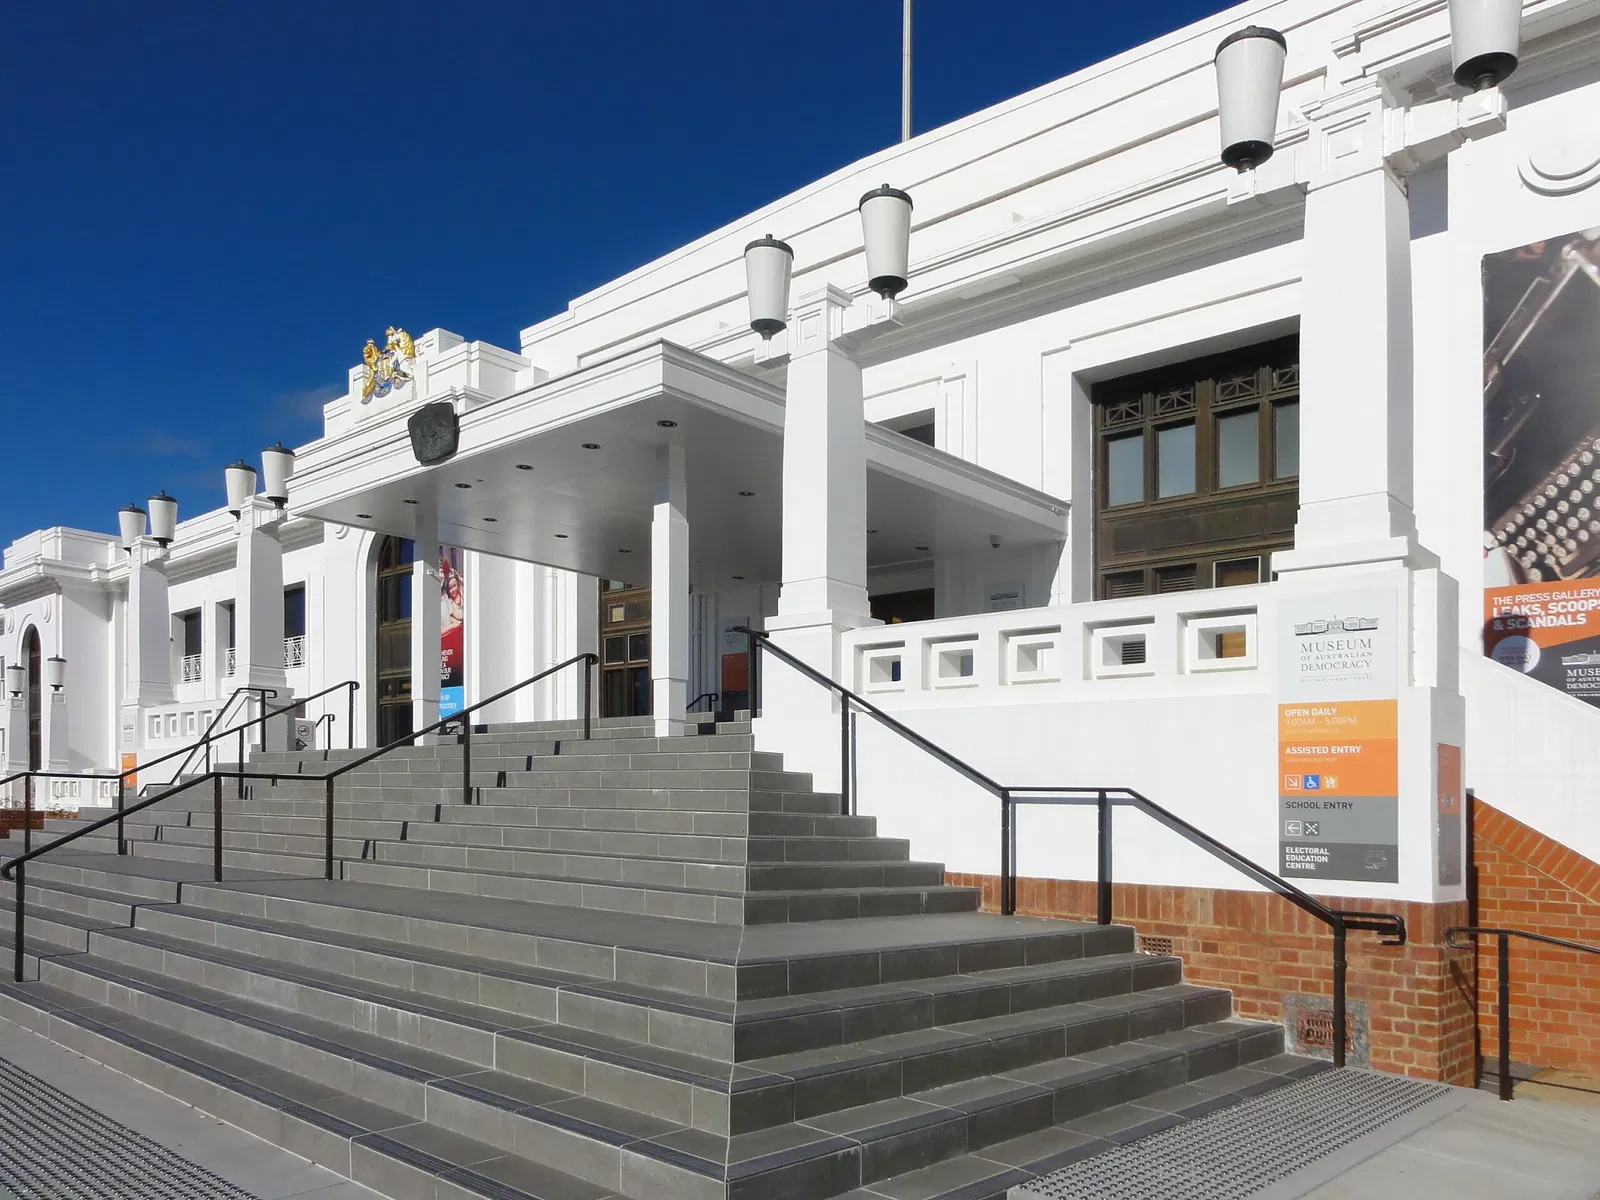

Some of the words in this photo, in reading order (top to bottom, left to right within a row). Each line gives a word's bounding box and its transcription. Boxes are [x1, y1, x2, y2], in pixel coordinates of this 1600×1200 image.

[1493, 597, 1512, 605] THE
[1516, 593, 1549, 603] PRESS
[1493, 604, 1545, 618] LEAKS,
[1493, 619, 1504, 631] &
[1507, 613, 1586, 629] SCANDALS
[1300, 638, 1373, 653] MUSEUM
[1314, 652, 1373, 660] AUSTRALIAN
[1300, 660, 1373, 672] DEMOCRACY
[1285, 708, 1309, 717] OPEN
[1311, 707, 1337, 716] DAILY
[1285, 746, 1329, 755] ASSISTED
[1331, 745, 1362, 754] ENTRY
[1285, 801, 1321, 809] SCHOOL
[1323, 802, 1353, 810] ENTRY
[1285, 846, 1330, 855] ELECTORAL
[1285, 854, 1328, 863] EDUCATION
[1285, 862, 1316, 870] CENTRE
